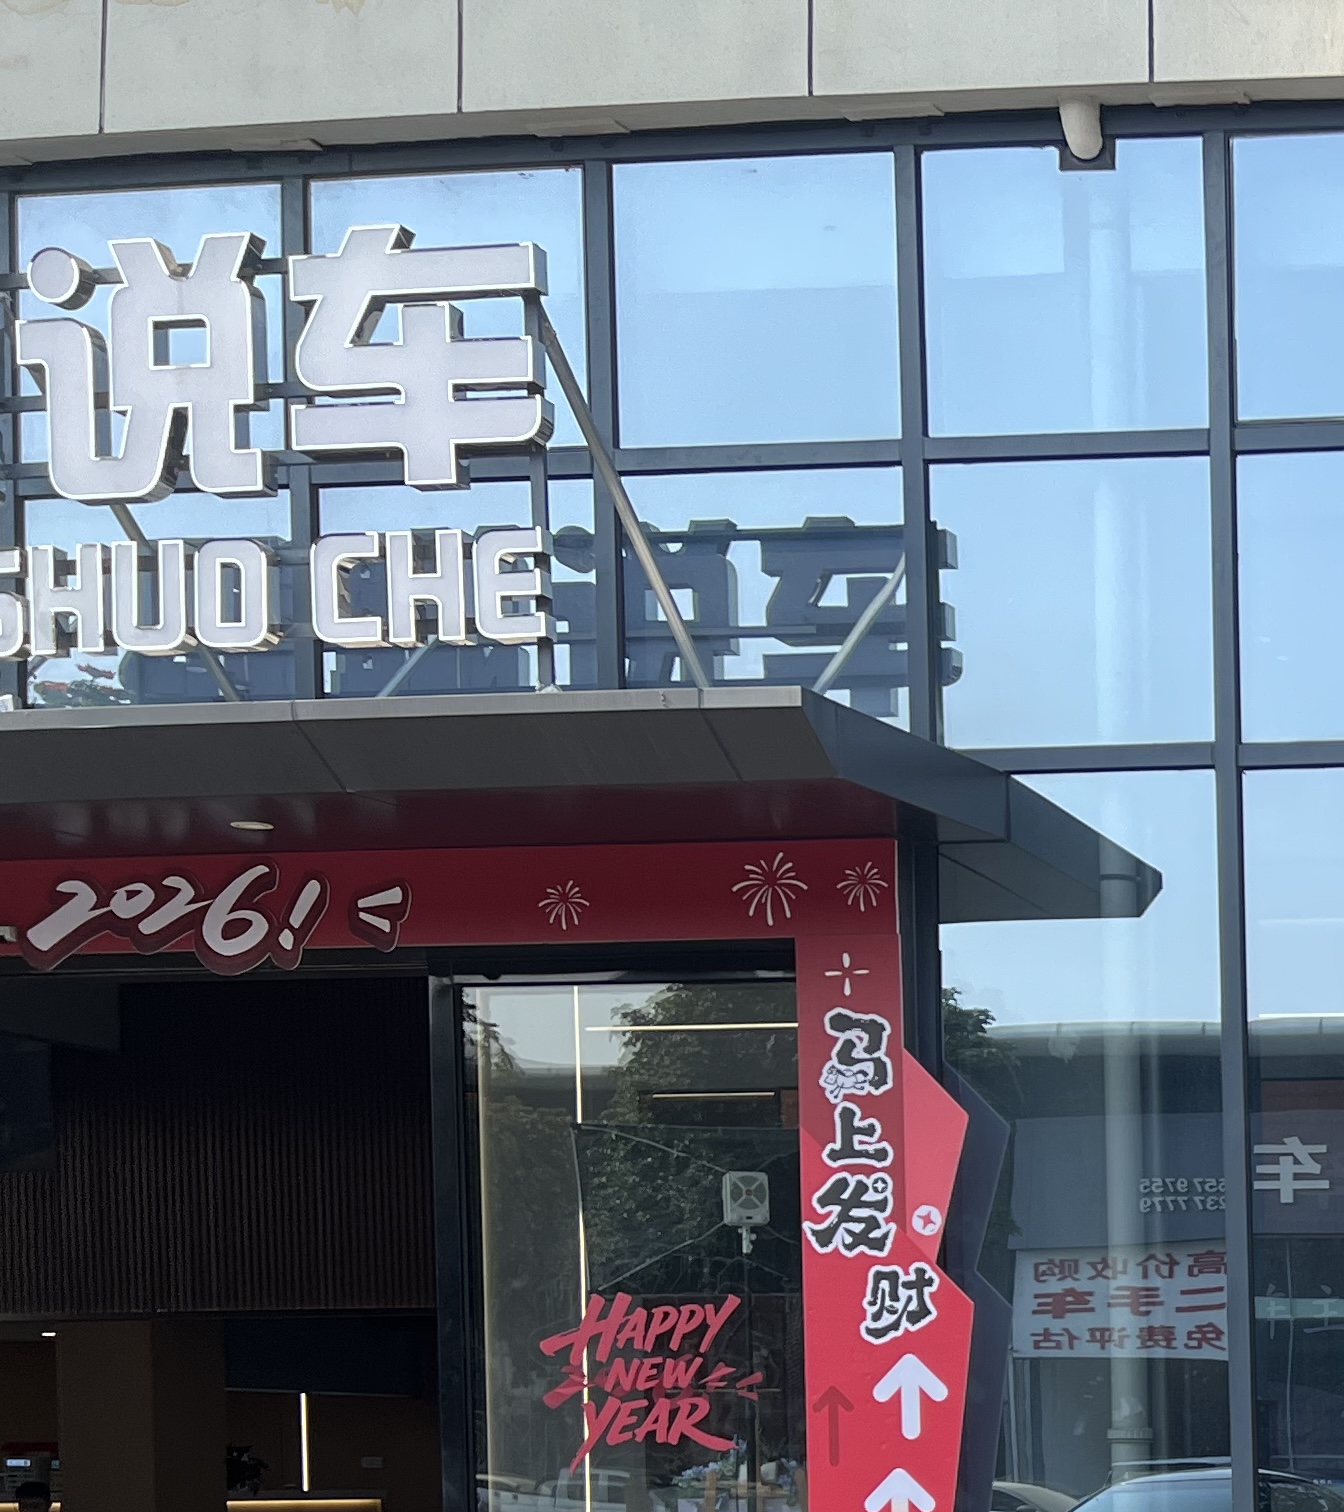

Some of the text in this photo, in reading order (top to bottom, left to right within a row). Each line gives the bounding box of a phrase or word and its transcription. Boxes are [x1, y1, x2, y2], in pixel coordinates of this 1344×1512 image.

[14, 223, 553, 505] 说车
[310, 527, 556, 650] CHE
[26, 864, 322, 957] 2026!
[803, 1006, 938, 1344] 马上发财
[539, 1292, 743, 1366] HAPPY
[603, 1354, 703, 1391] NEW
[569, 1397, 741, 1472] YEAR
